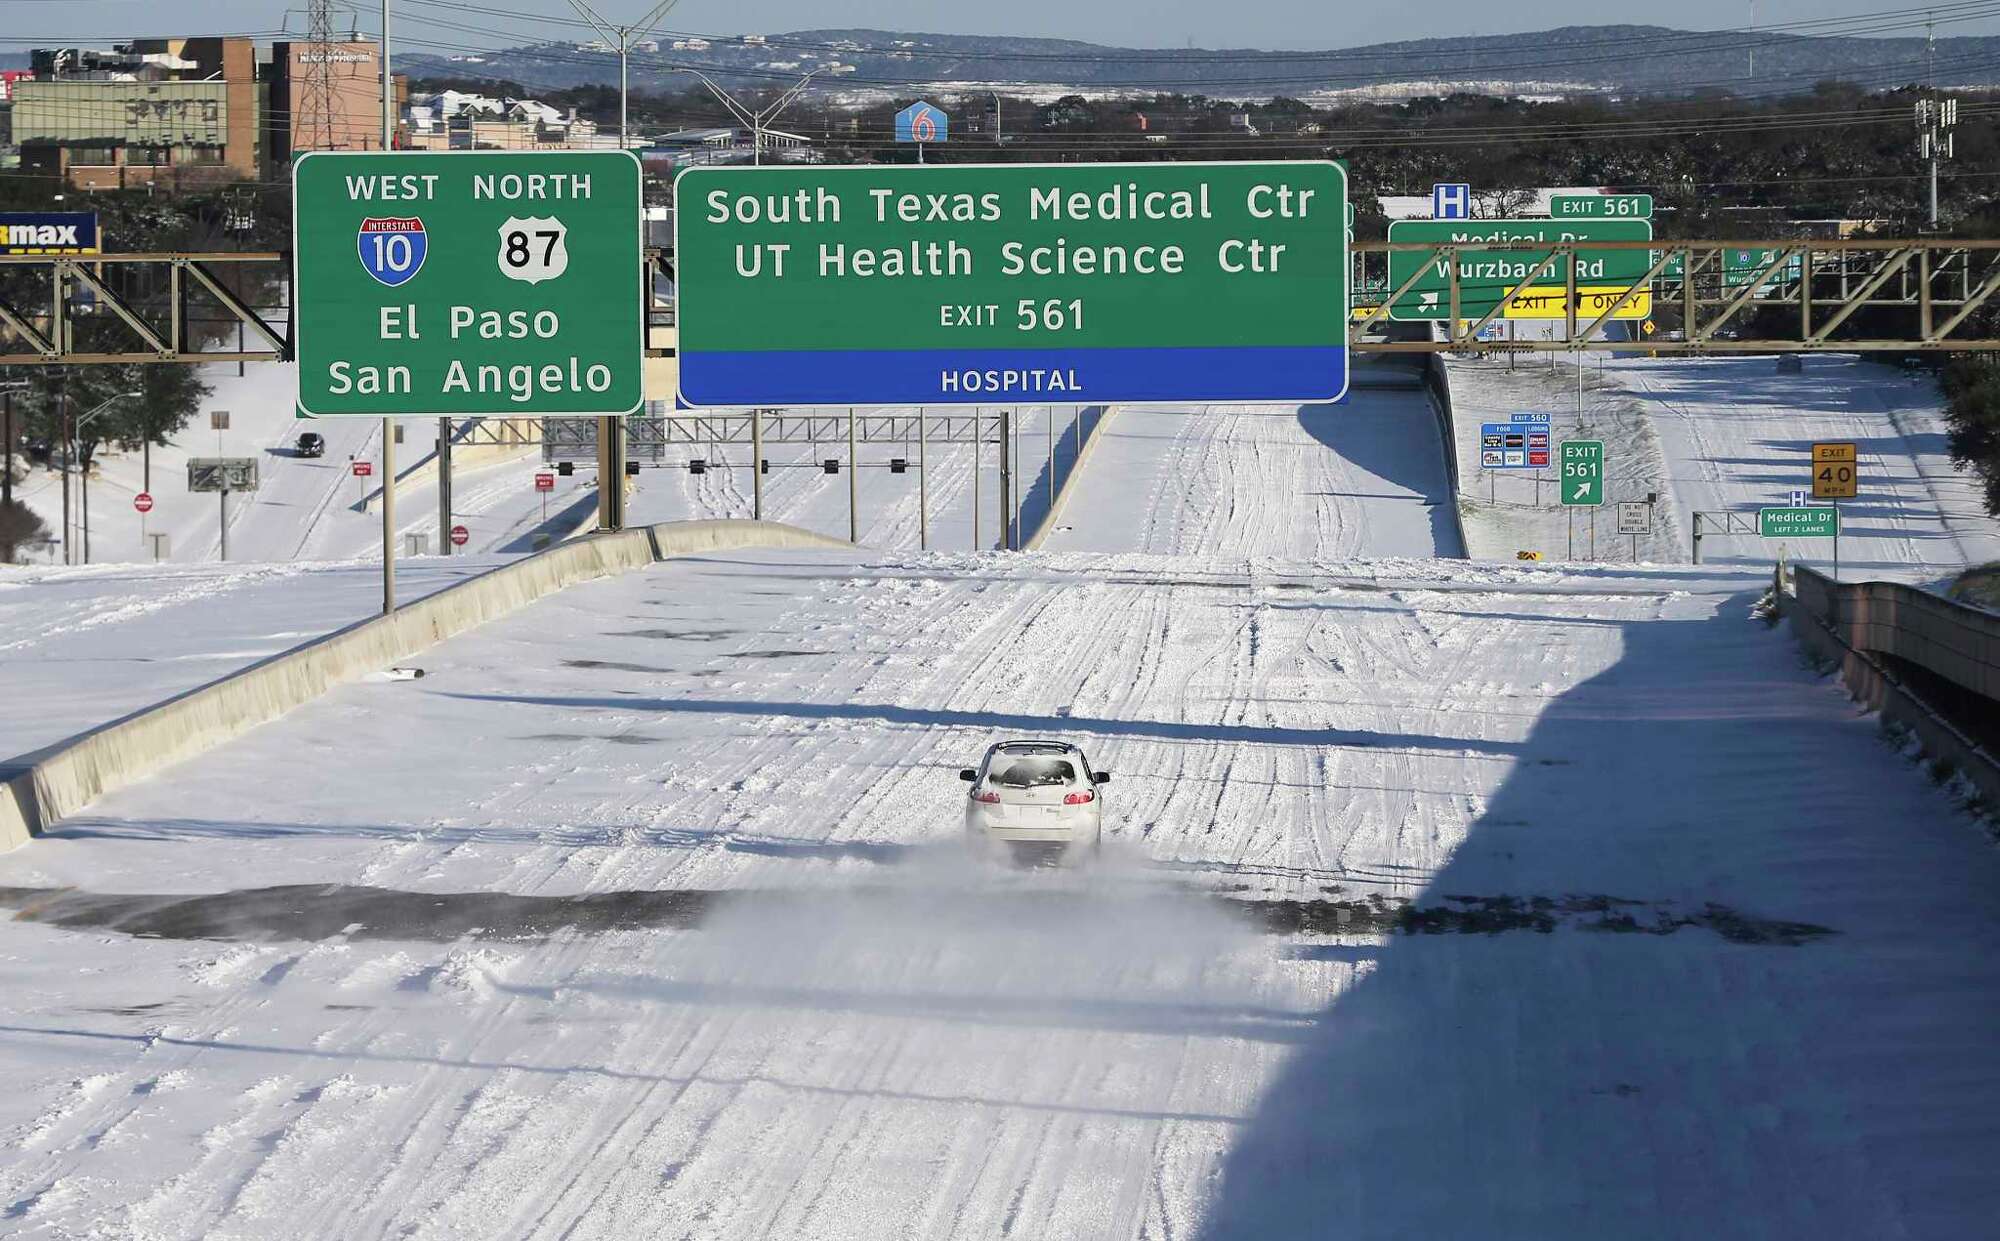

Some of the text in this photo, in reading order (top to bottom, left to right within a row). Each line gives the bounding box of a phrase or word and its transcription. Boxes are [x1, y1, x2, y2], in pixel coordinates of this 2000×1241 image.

[345, 174, 592, 200] WEST NORTH
[706, 183, 1315, 224] South Texas Medical Ctr
[1438, 187, 1464, 218] H
[1562, 198, 1639, 215] EXIT 561
[368, 221, 416, 231] INTERSTATE
[373, 235, 412, 272] 10
[505, 230, 560, 268] 87
[735, 238, 1286, 277] UT Health Science Ctr
[1576, 259, 1603, 278] Rd
[1512, 296, 1549, 308] EXIT
[380, 304, 560, 339] El Paso
[940, 299, 1083, 330] EXIT 561
[328, 357, 612, 402] San Angelo
[942, 369, 1082, 392] HOSPITAL
[1566, 447, 1598, 457] EXIT
[1821, 448, 1846, 457] EXIT
[1565, 462, 1597, 477] 561
[1818, 467, 1851, 483] 40
[1791, 491, 1805, 507] H
[1767, 512, 1832, 522] Medical Dr
